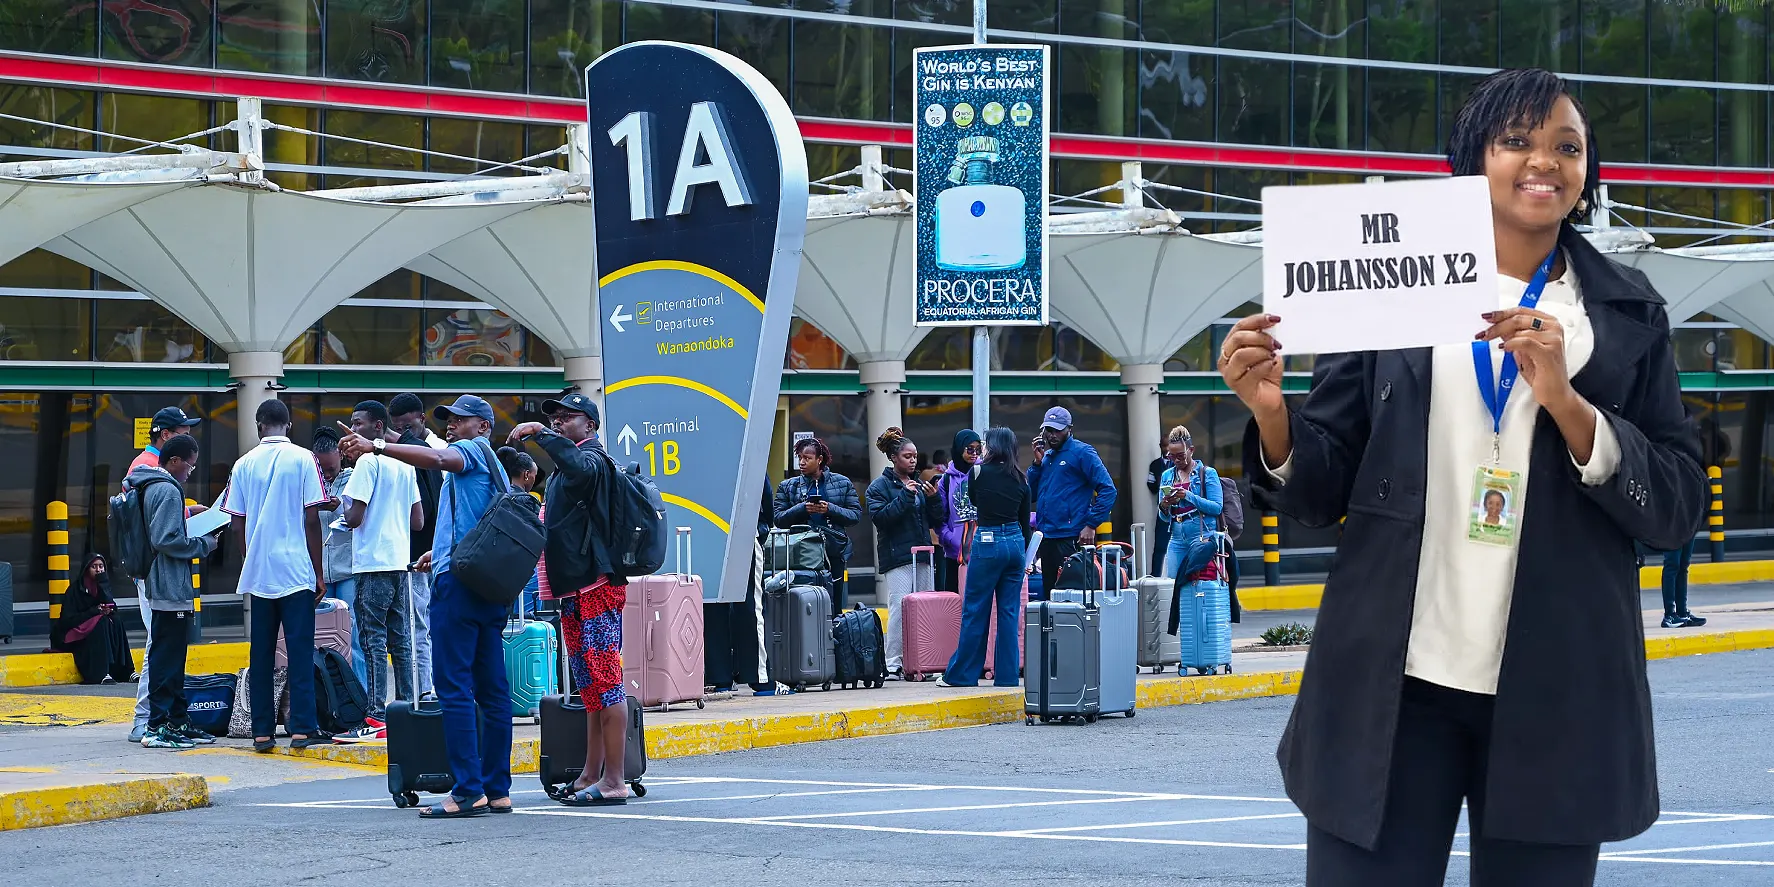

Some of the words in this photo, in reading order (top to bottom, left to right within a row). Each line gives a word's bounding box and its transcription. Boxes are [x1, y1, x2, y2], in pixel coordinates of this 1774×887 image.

[922, 58, 992, 74] WORLD'S
[996, 57, 1037, 72] BEST
[923, 76, 951, 91] GIN
[956, 79, 970, 90] IS
[973, 75, 1035, 89] KENYAN
[607, 101, 753, 221] 1A
[1360, 212, 1401, 244] MR
[1283, 255, 1435, 298] JOHANSSON
[1443, 252, 1478, 285] X2
[924, 278, 1037, 304] PROCERA
[654, 292, 724, 312] International
[924, 307, 979, 316] EQUATORIAL
[980, 307, 1019, 315] AFRICAN
[1021, 306, 1037, 315] GIN
[655, 316, 715, 334] Departures
[656, 335, 735, 356] Wanaondoka
[643, 415, 700, 436] Terminal
[643, 439, 681, 477] 1B
[194, 701, 220, 709] SPORT
